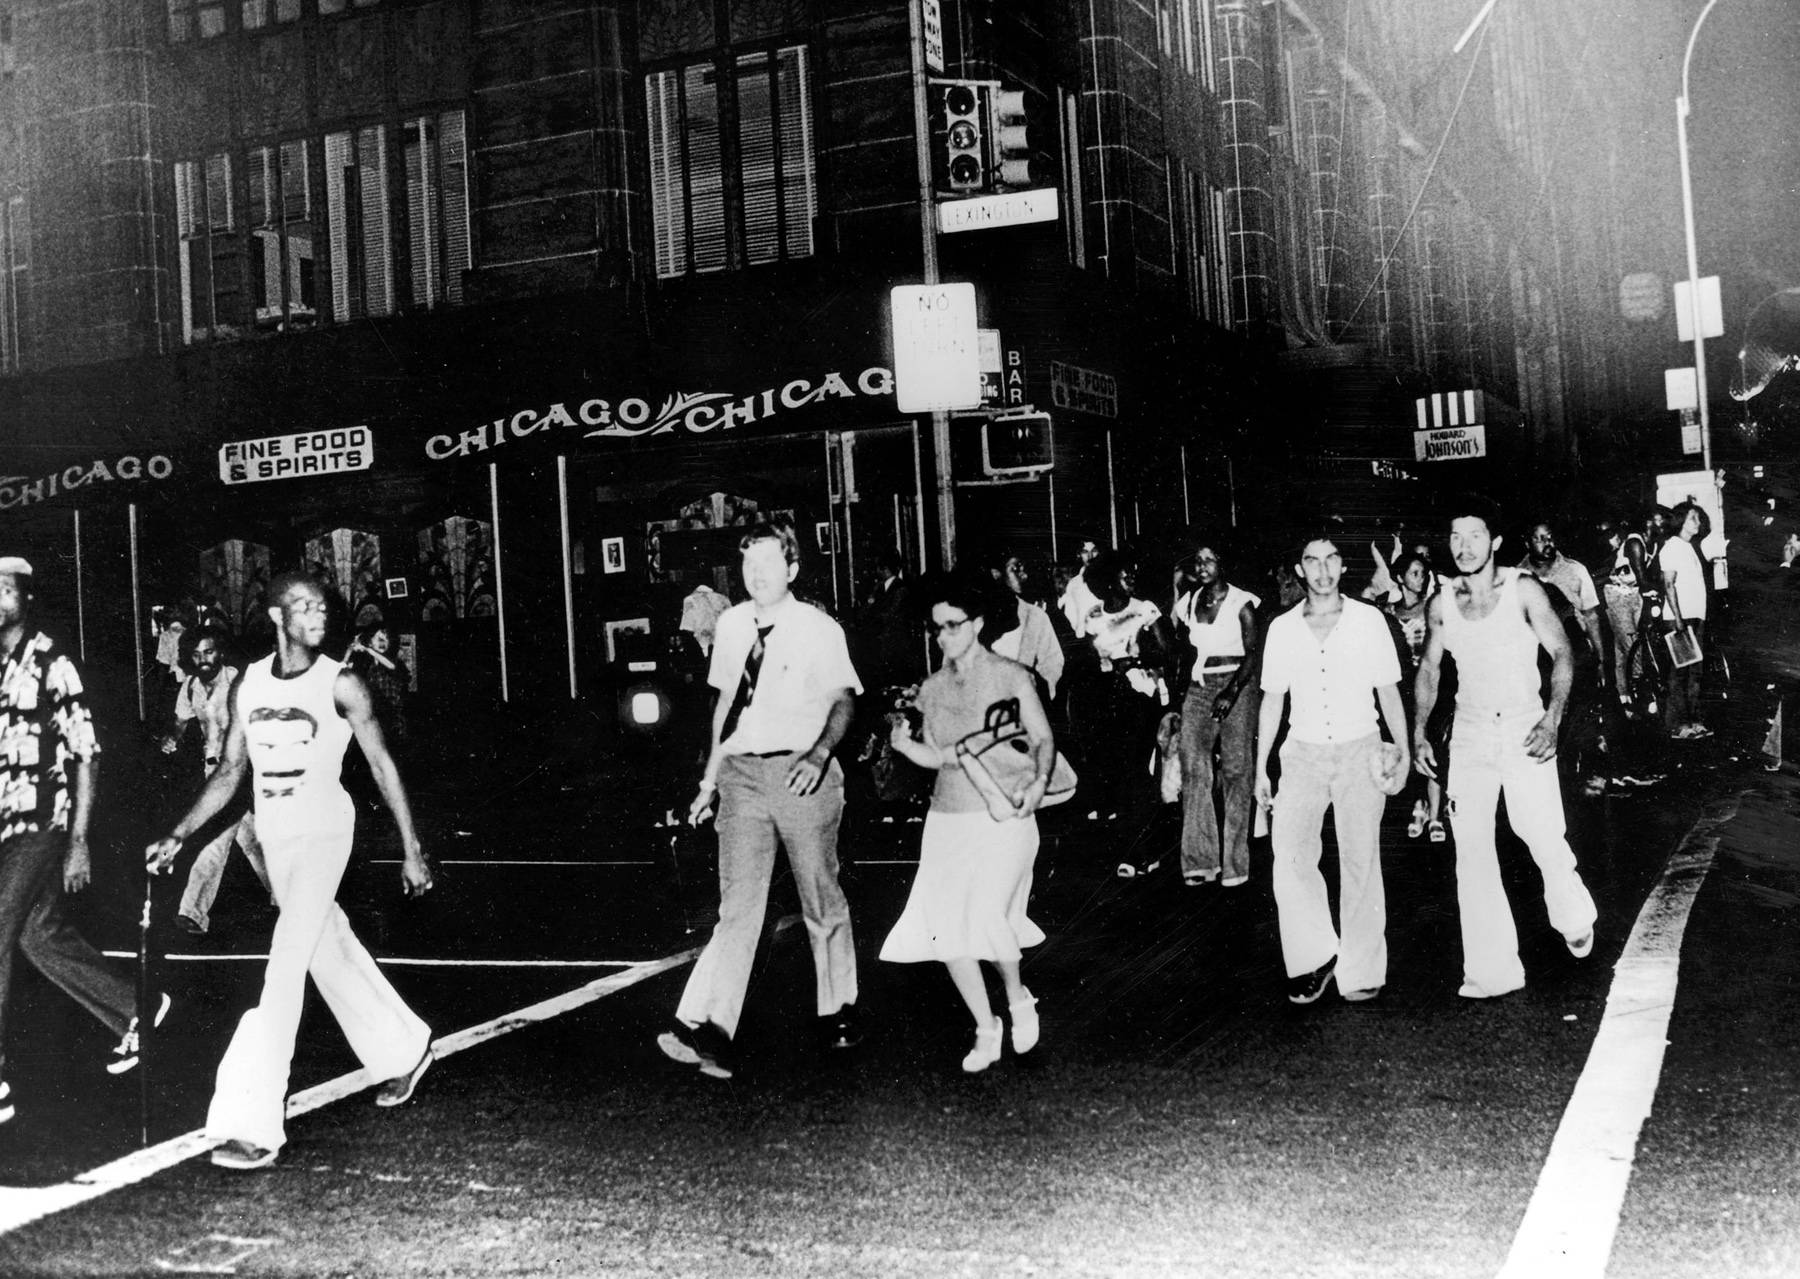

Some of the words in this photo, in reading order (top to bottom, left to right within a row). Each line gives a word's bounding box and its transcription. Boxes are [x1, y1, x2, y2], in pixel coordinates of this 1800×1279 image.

[946, 199, 1034, 227] LEXINGTON
[917, 293, 950, 312] NO
[1007, 350, 1023, 403] BAR
[425, 397, 650, 460] CHICAGO
[685, 366, 895, 432] CHICAG
[225, 439, 282, 463] FINE
[294, 429, 366, 454] FOOD
[1429, 429, 1466, 441] HOWARD
[0, 455, 173, 509] CHICAGO
[230, 464, 248, 482] &
[258, 450, 363, 478] SPIRITS
